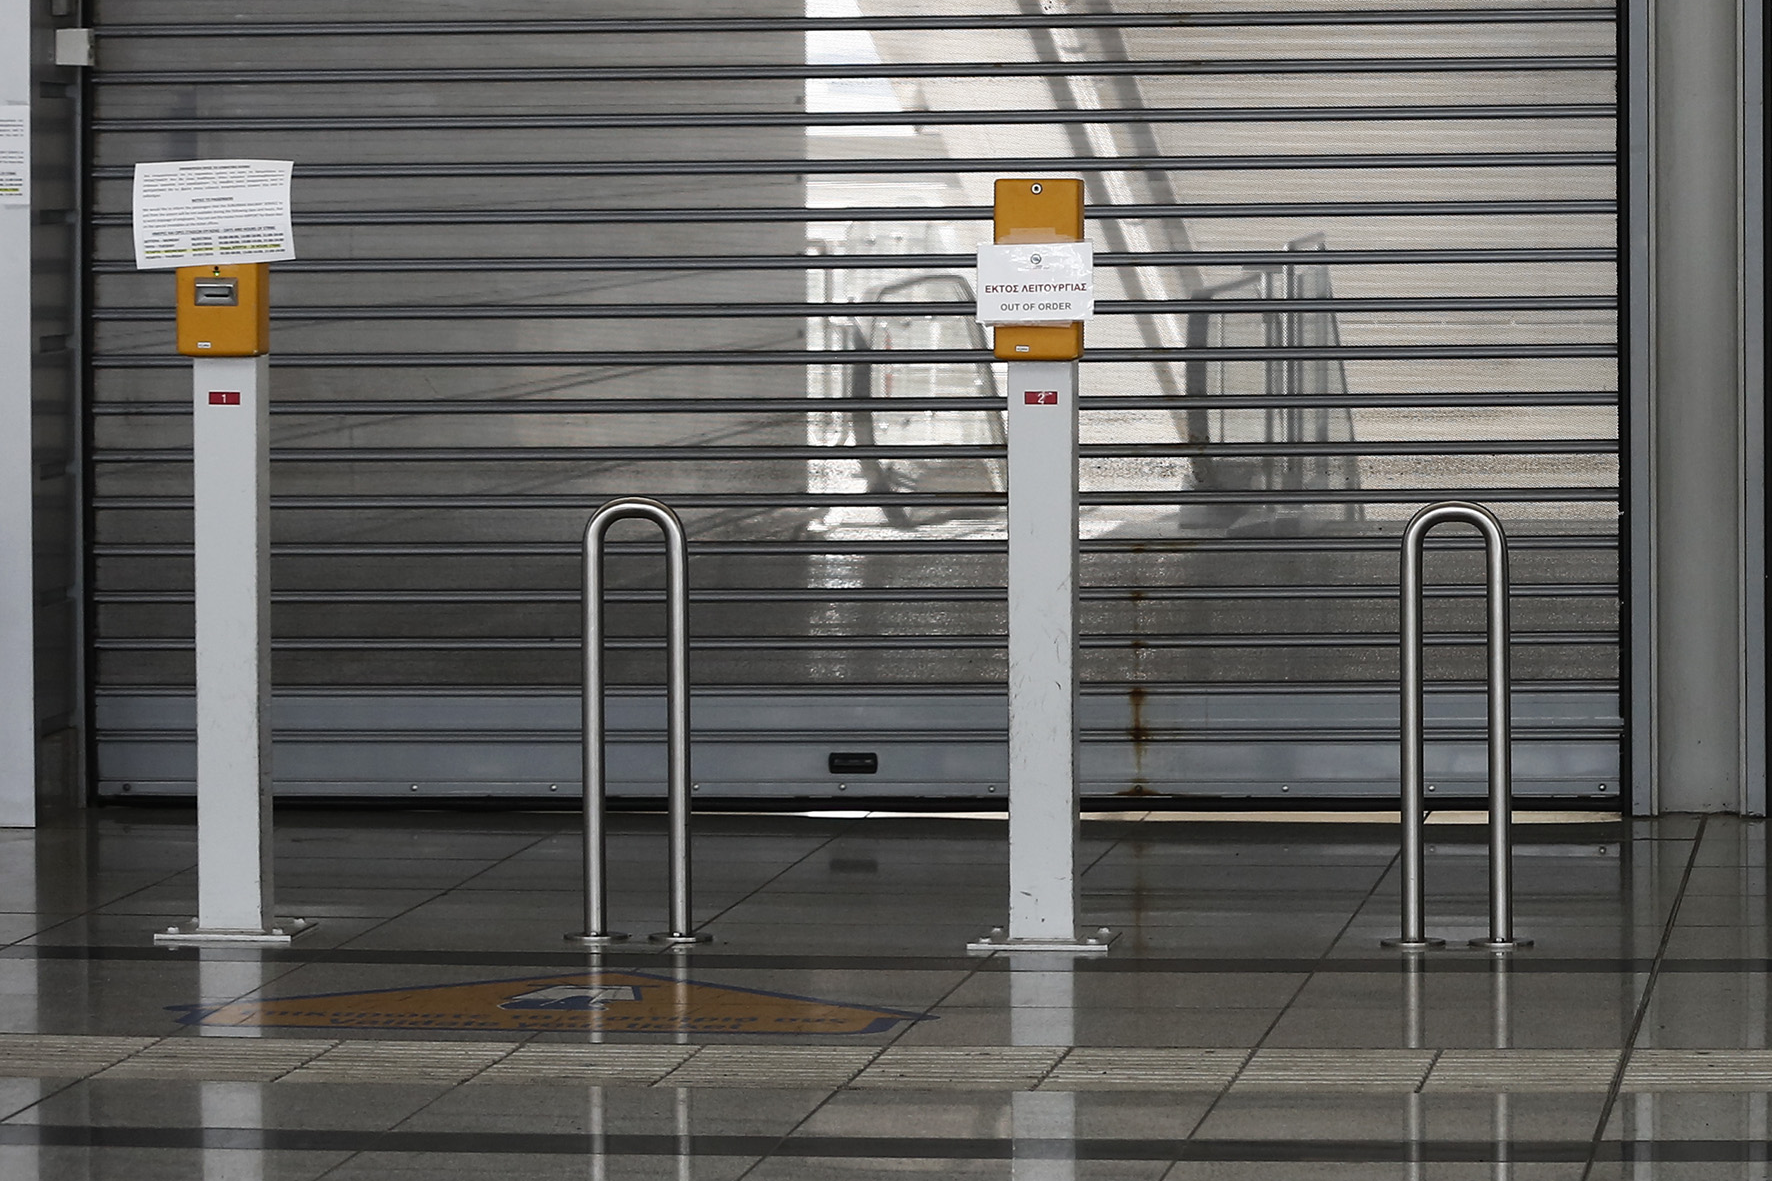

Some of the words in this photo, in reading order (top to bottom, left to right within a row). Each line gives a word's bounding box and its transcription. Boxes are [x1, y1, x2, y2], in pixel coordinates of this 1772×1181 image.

[984, 284, 1019, 294] ΕΚΤΟΣ
[1021, 282, 1087, 293] ΛΕΙΤΟΥΡΓΙΑΣ
[1000, 302, 1021, 312] OUT
[1023, 302, 1036, 312] OF
[1038, 301, 1072, 312] ORDER
[221, 393, 228, 404] 1
[1036, 391, 1046, 404] 2
